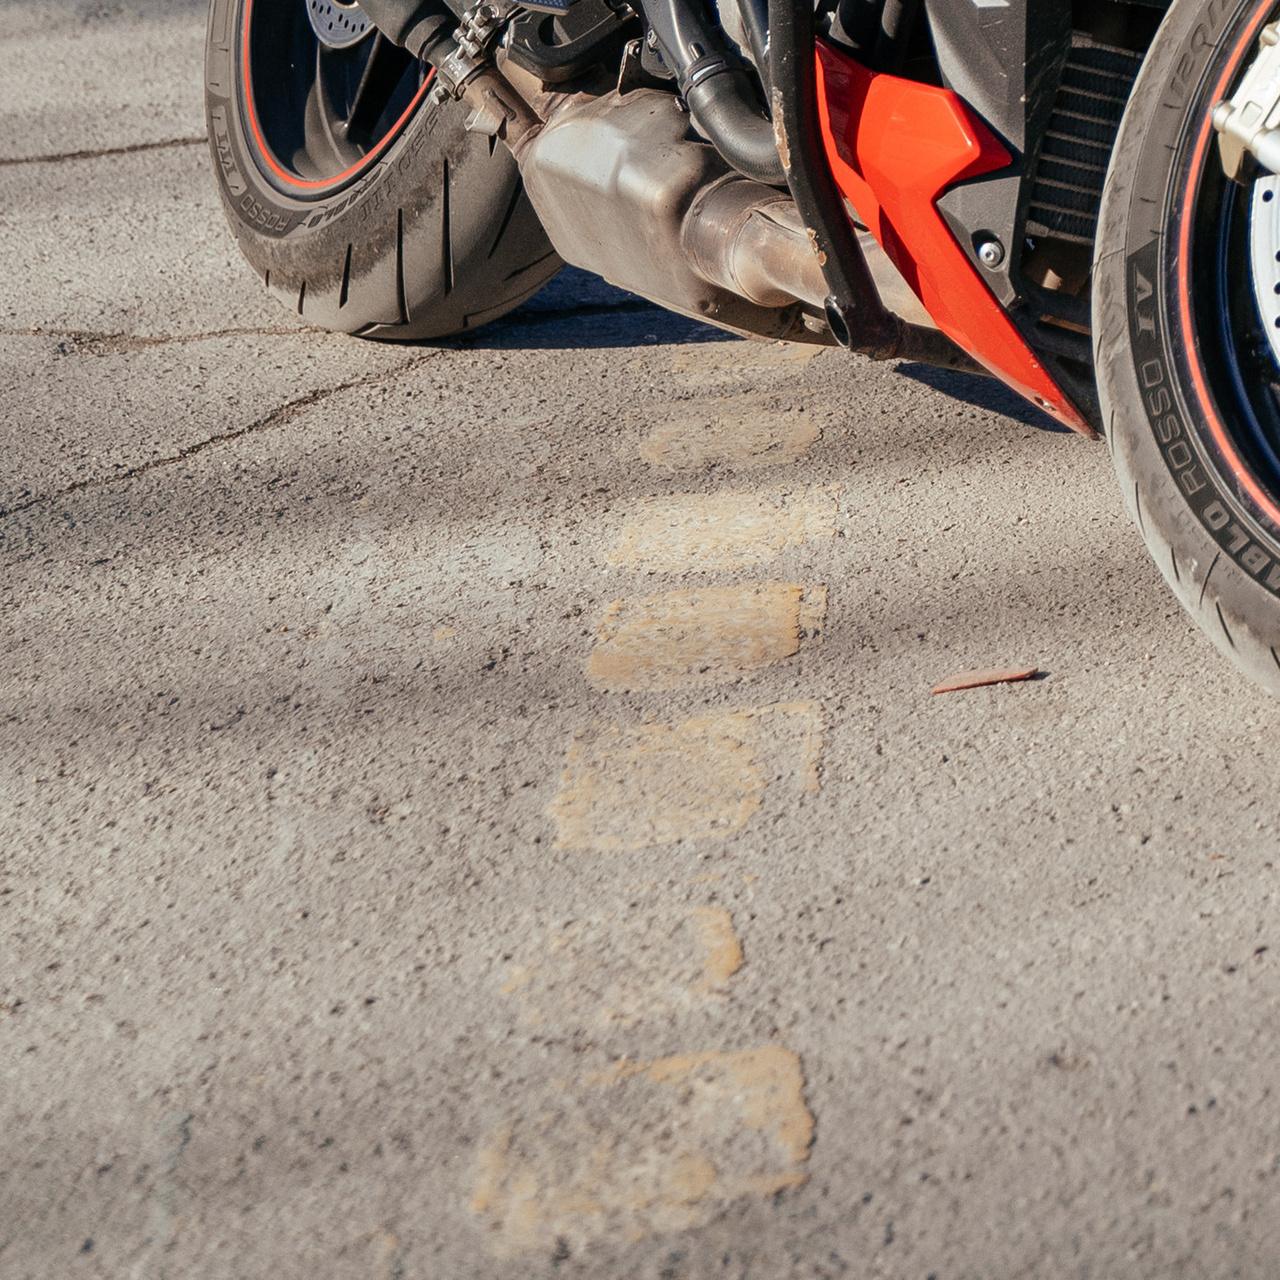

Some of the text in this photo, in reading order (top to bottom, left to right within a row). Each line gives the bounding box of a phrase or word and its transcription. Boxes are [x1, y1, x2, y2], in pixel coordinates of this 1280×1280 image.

[240, 195, 292, 232] ROSSO
[1132, 260, 1156, 338] IV
[1140, 357, 1207, 495] ROSSO
